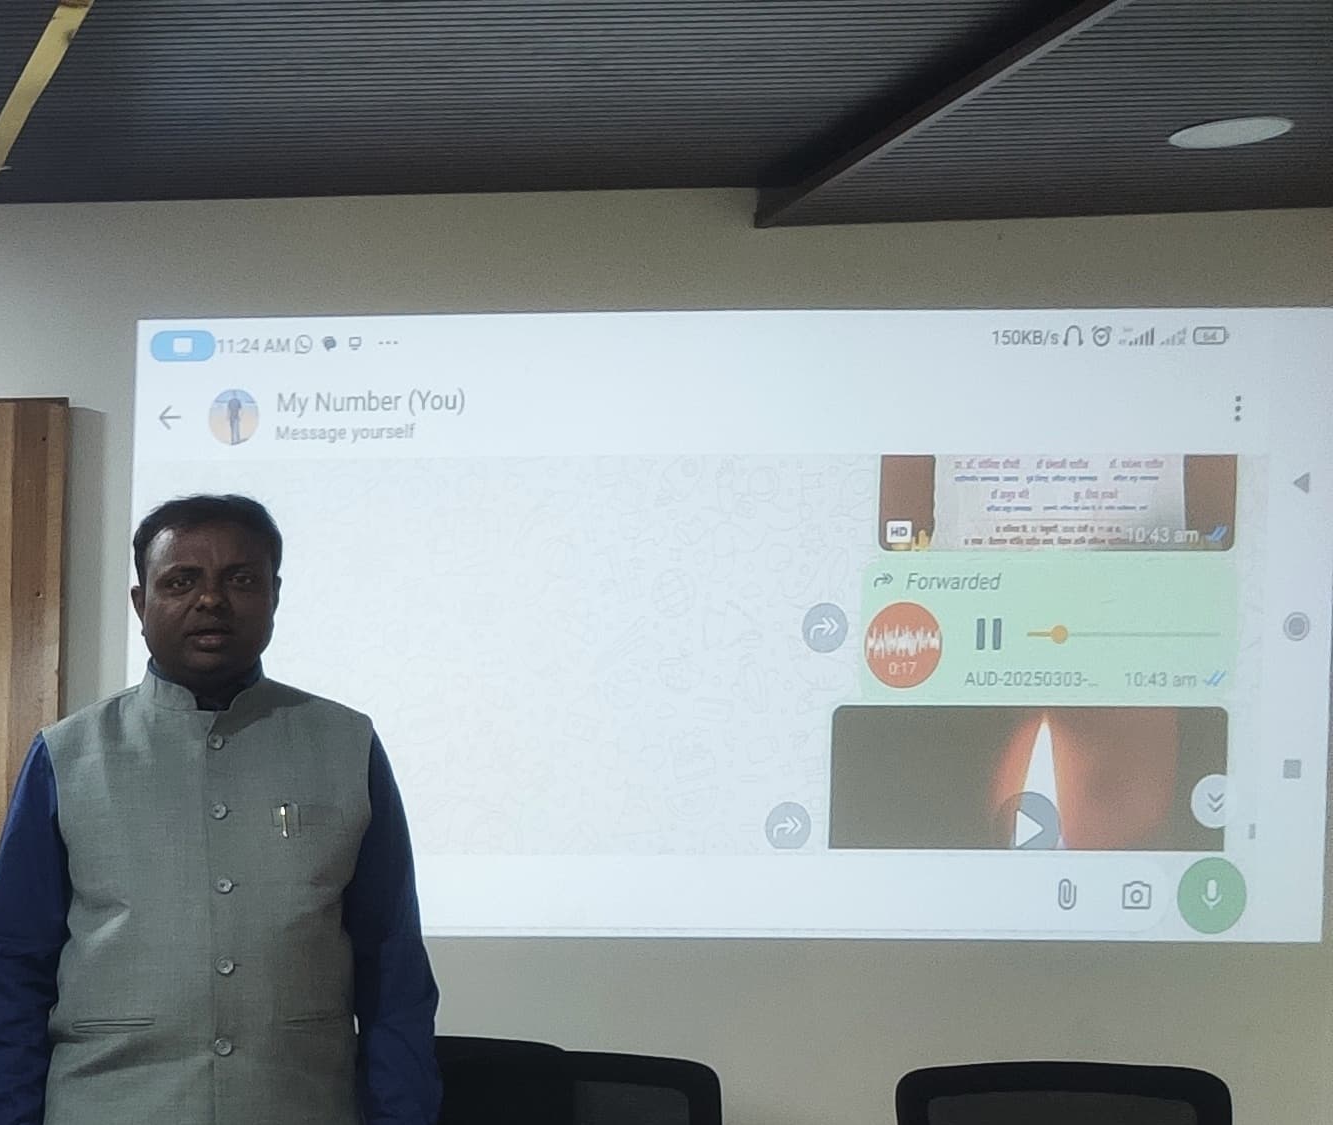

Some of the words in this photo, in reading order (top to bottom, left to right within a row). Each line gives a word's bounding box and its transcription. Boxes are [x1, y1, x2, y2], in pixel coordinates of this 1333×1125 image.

[217, 338, 260, 354] 11:24
[264, 337, 291, 353] AM
[991, 329, 1060, 347] 150KB/s
[276, 392, 309, 418] My
[315, 390, 403, 413] Number
[408, 387, 466, 416] (You)
[275, 425, 346, 443] Message
[351, 423, 416, 442] yourself
[890, 526, 908, 537] HD
[1174, 530, 1199, 543] am
[905, 572, 1002, 590] Forwarded
[888, 661, 917, 676] 0:17
[1124, 671, 1168, 688] 10:43
[1172, 674, 1197, 687] am
